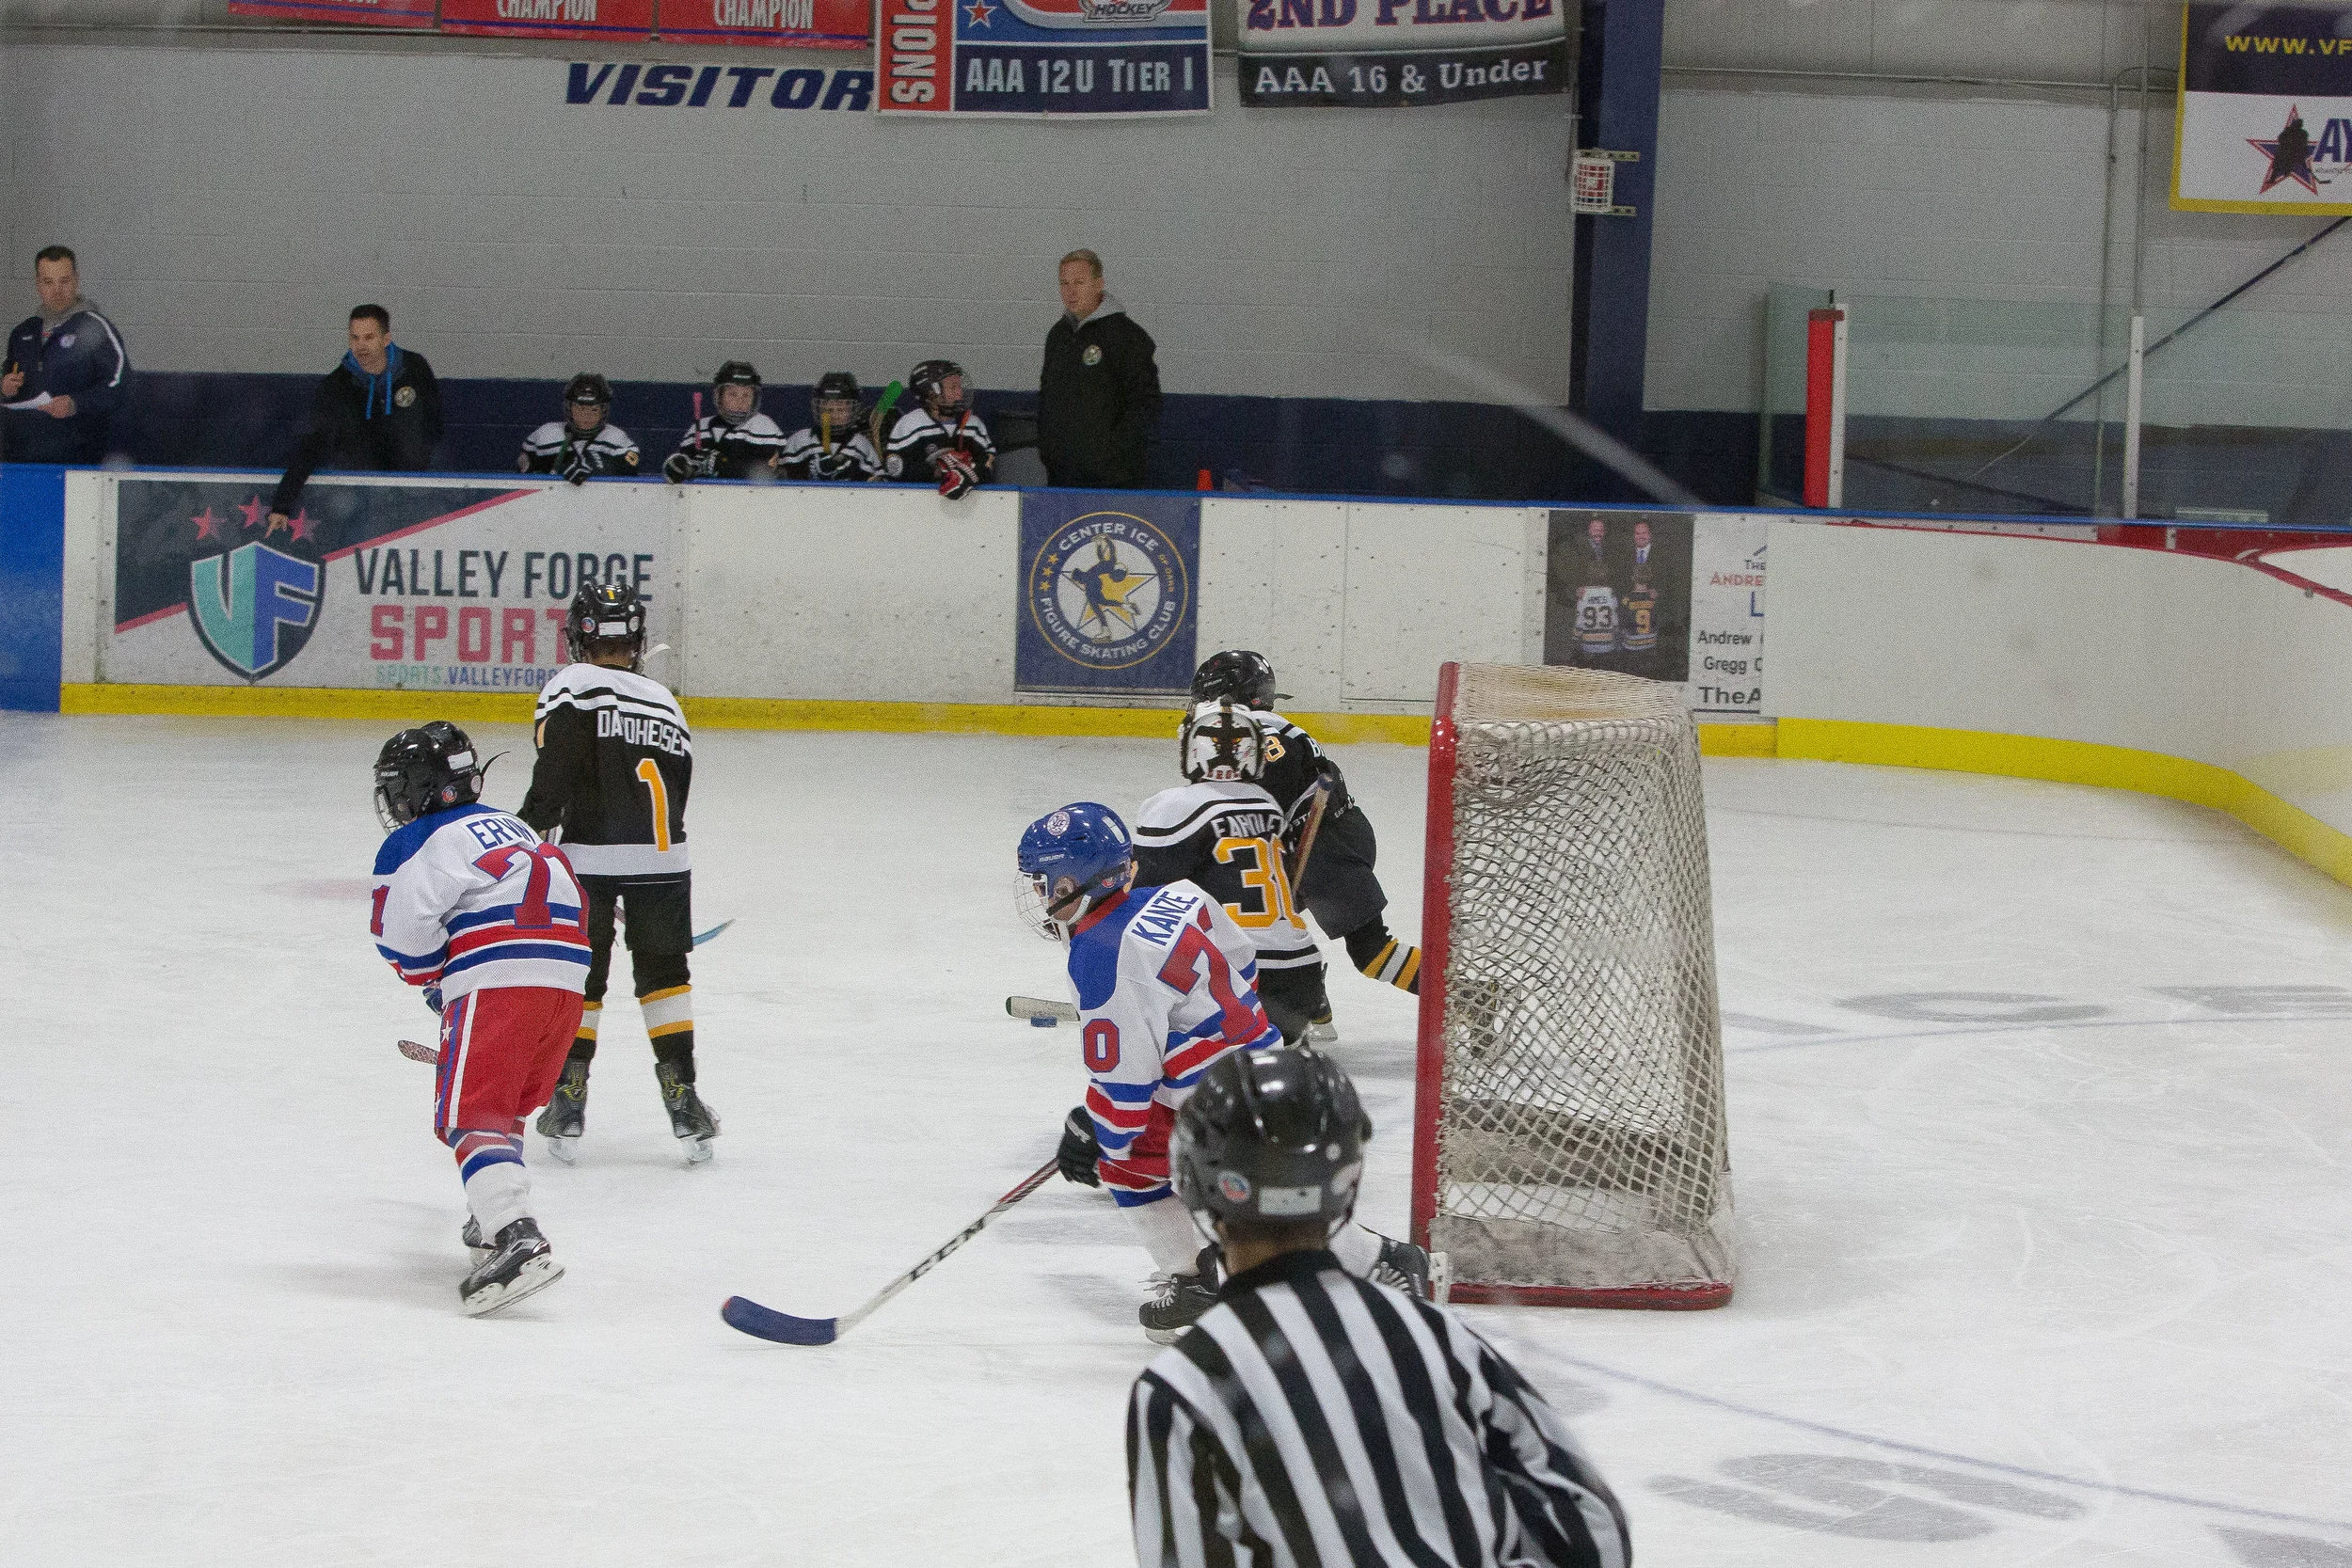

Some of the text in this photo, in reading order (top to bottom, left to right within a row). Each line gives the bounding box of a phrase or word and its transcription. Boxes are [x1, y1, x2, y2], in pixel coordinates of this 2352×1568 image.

[712, 0, 814, 29] CHAMPION
[1247, 0, 1552, 30] 2ND PLACE
[965, 57, 1025, 92] AAA
[1038, 58, 1093, 93] 12U
[1255, 58, 1549, 93] AAA 16 & Under
[1059, 522, 1126, 551] CENTER
[1130, 528, 1159, 551] ICE
[355, 547, 654, 602] VALLEY FORGE
[1040, 596, 1177, 659] FIGURE SKATING CLUB
[1697, 631, 1752, 645] Andrew
[1704, 656, 1747, 674] Gregg
[636, 758, 672, 852] 1
[1132, 891, 1200, 946] KANZE
[1083, 1018, 1120, 1073] 0
